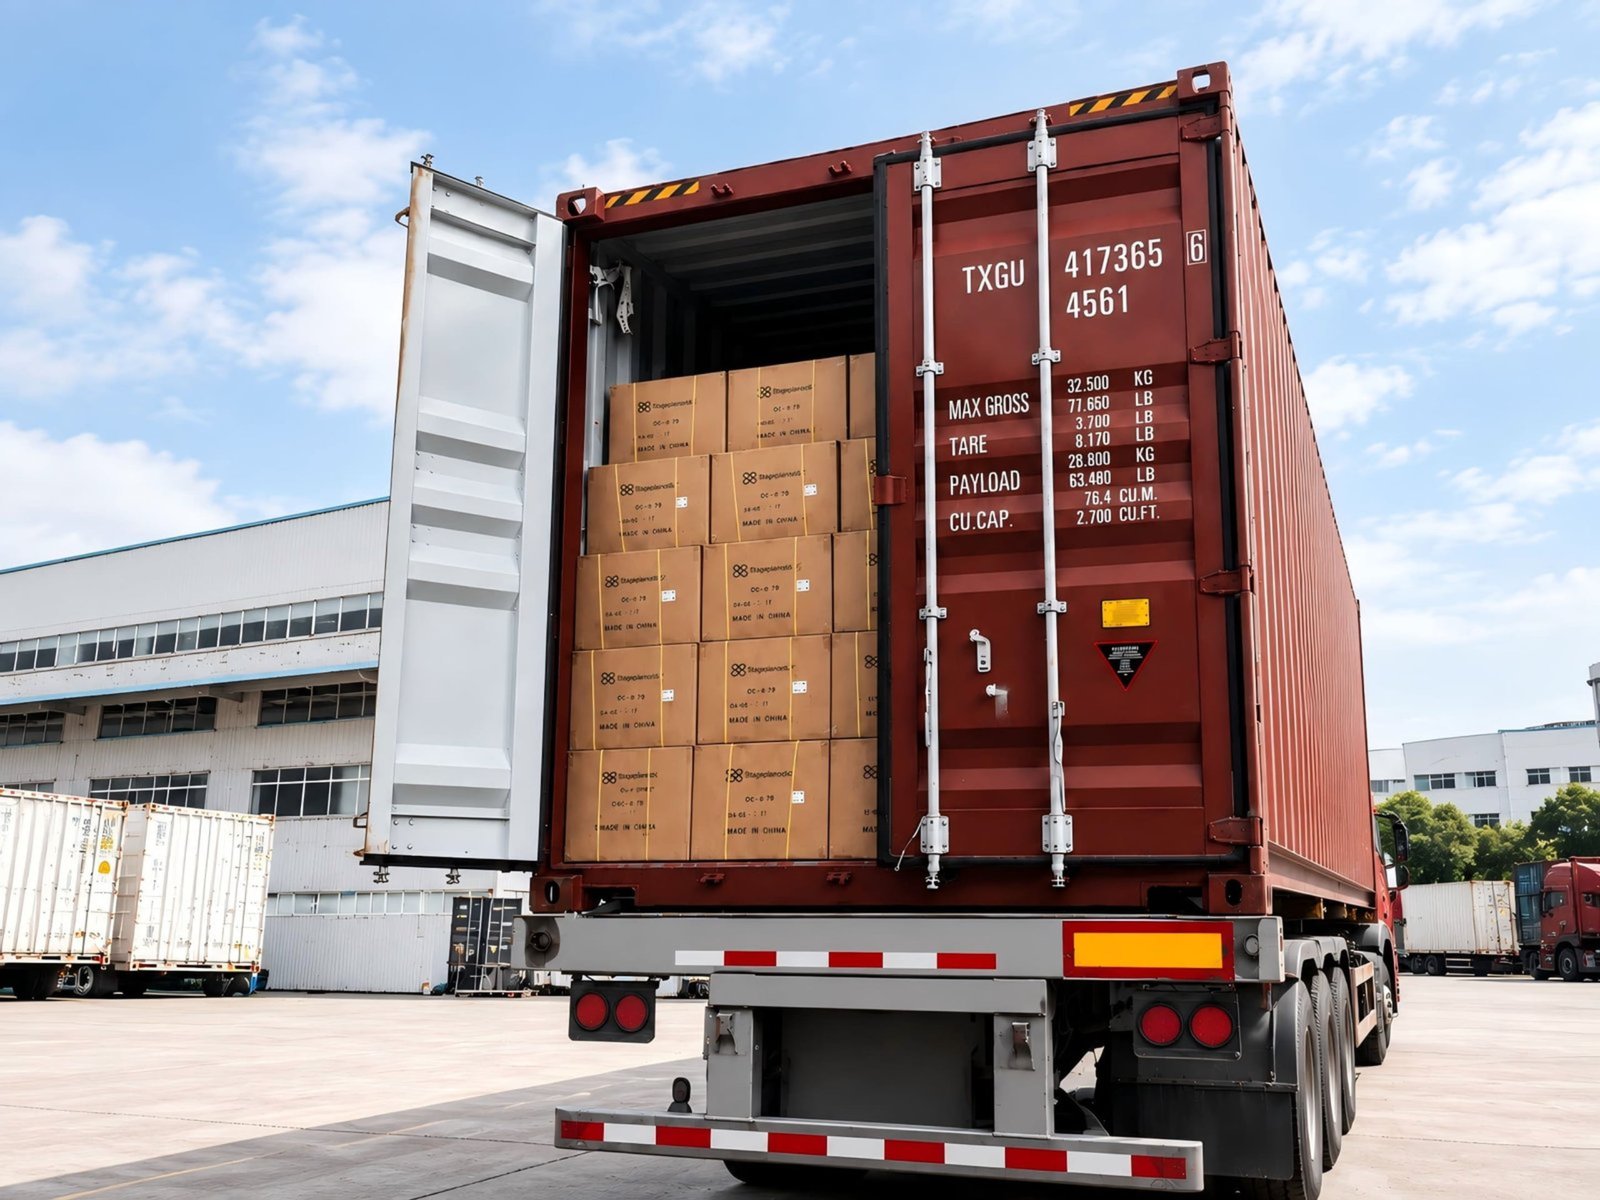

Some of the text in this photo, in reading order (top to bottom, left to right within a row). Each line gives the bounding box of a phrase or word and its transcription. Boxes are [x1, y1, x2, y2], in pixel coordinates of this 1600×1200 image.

[962, 232, 1205, 294] TXGU 417365 6
[1066, 285, 1128, 318] 4561
[1067, 369, 1153, 394] 32.500 KG
[949, 392, 1030, 420] MAX GROSS
[1135, 390, 1153, 406] LB
[1075, 410, 1153, 430] 3.700 LB
[949, 434, 987, 456] TARE
[1075, 426, 1154, 448] 8.170 LB
[1068, 446, 1155, 469] 28.800 KG
[950, 470, 1020, 496] PAYLOAD
[1069, 467, 1155, 488] 63.480 LB
[1084, 486, 1157, 506] 76.4 CU.M.
[950, 509, 1013, 532] CU.CAP.
[1076, 504, 1160, 525] 2.700 CU.FT.
